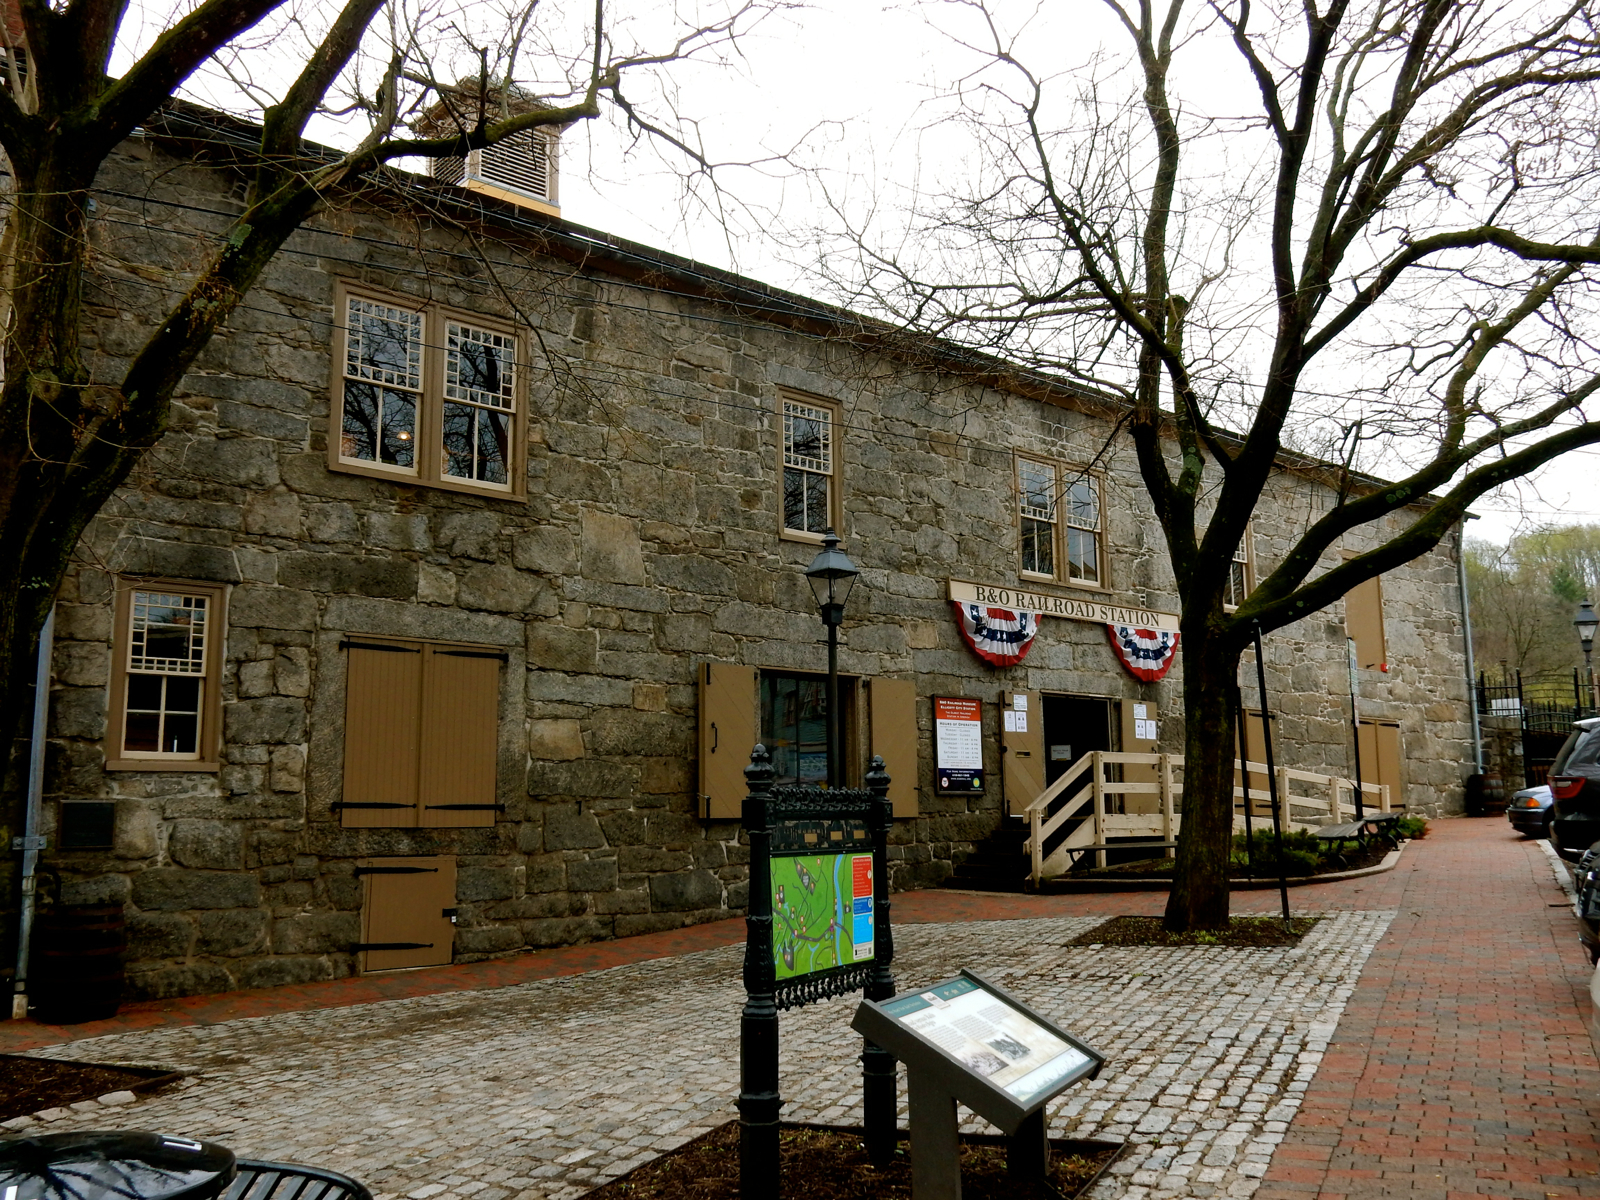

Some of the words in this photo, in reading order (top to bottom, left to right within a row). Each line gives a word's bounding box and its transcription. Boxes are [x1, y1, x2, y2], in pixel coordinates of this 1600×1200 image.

[975, 586, 1010, 606] B&O
[1015, 592, 1096, 618] RAILROAD
[1100, 606, 1160, 627] STATION
